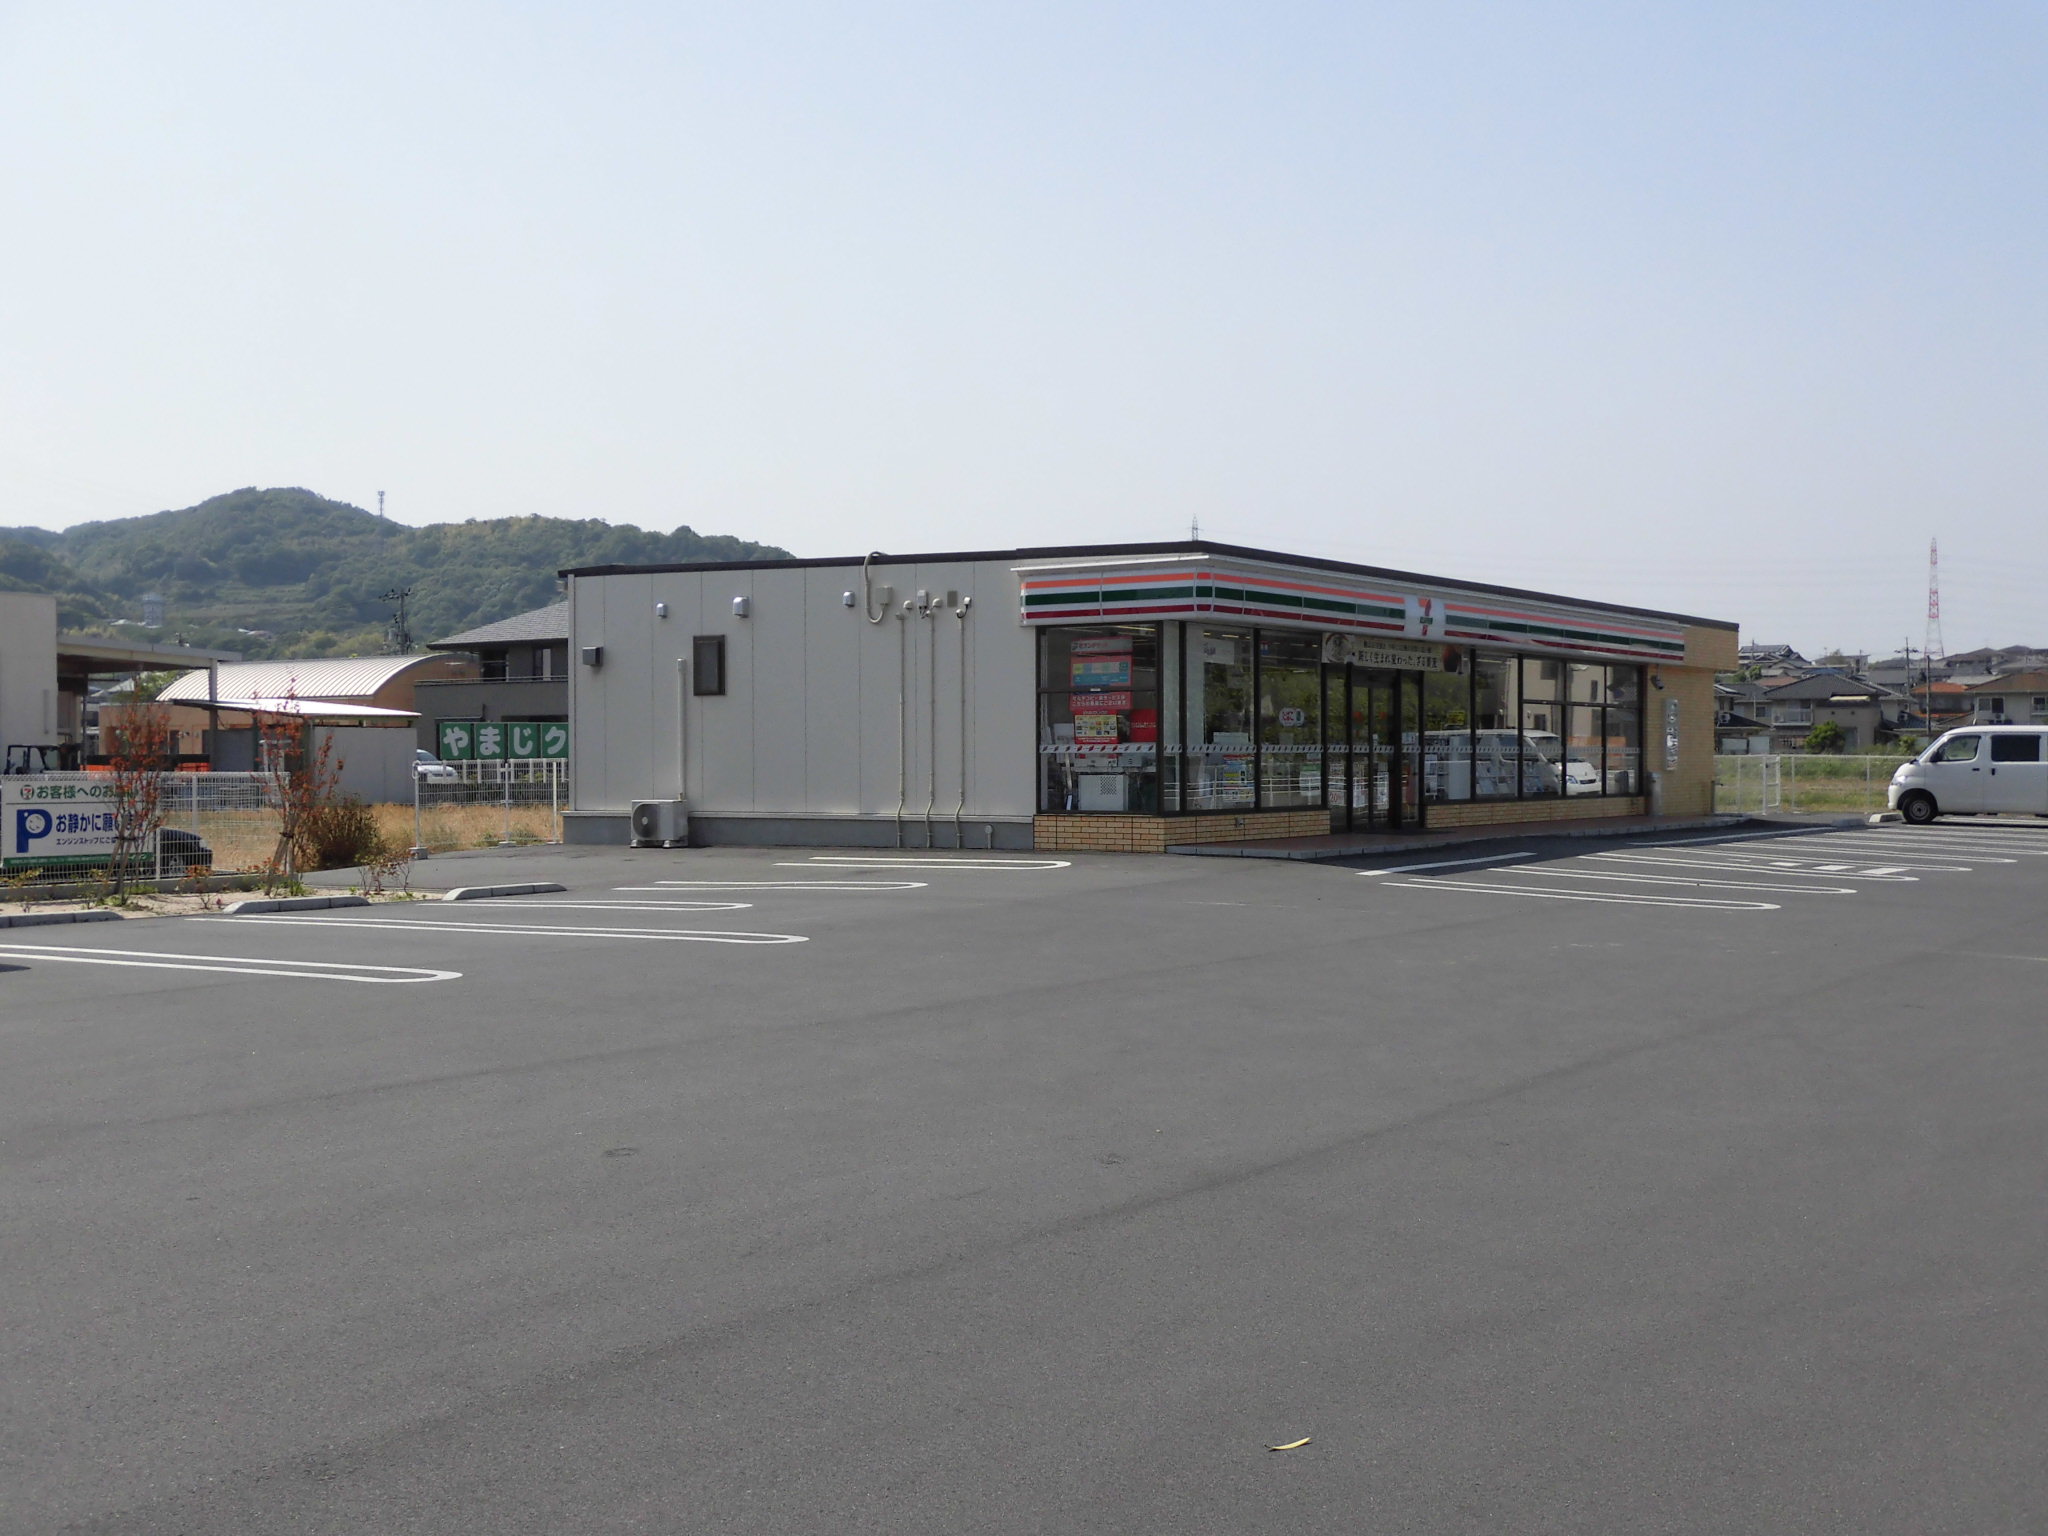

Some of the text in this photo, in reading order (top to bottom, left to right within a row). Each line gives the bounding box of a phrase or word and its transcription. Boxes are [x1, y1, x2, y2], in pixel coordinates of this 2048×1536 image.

[37, 785, 138, 799] お客様へのお
